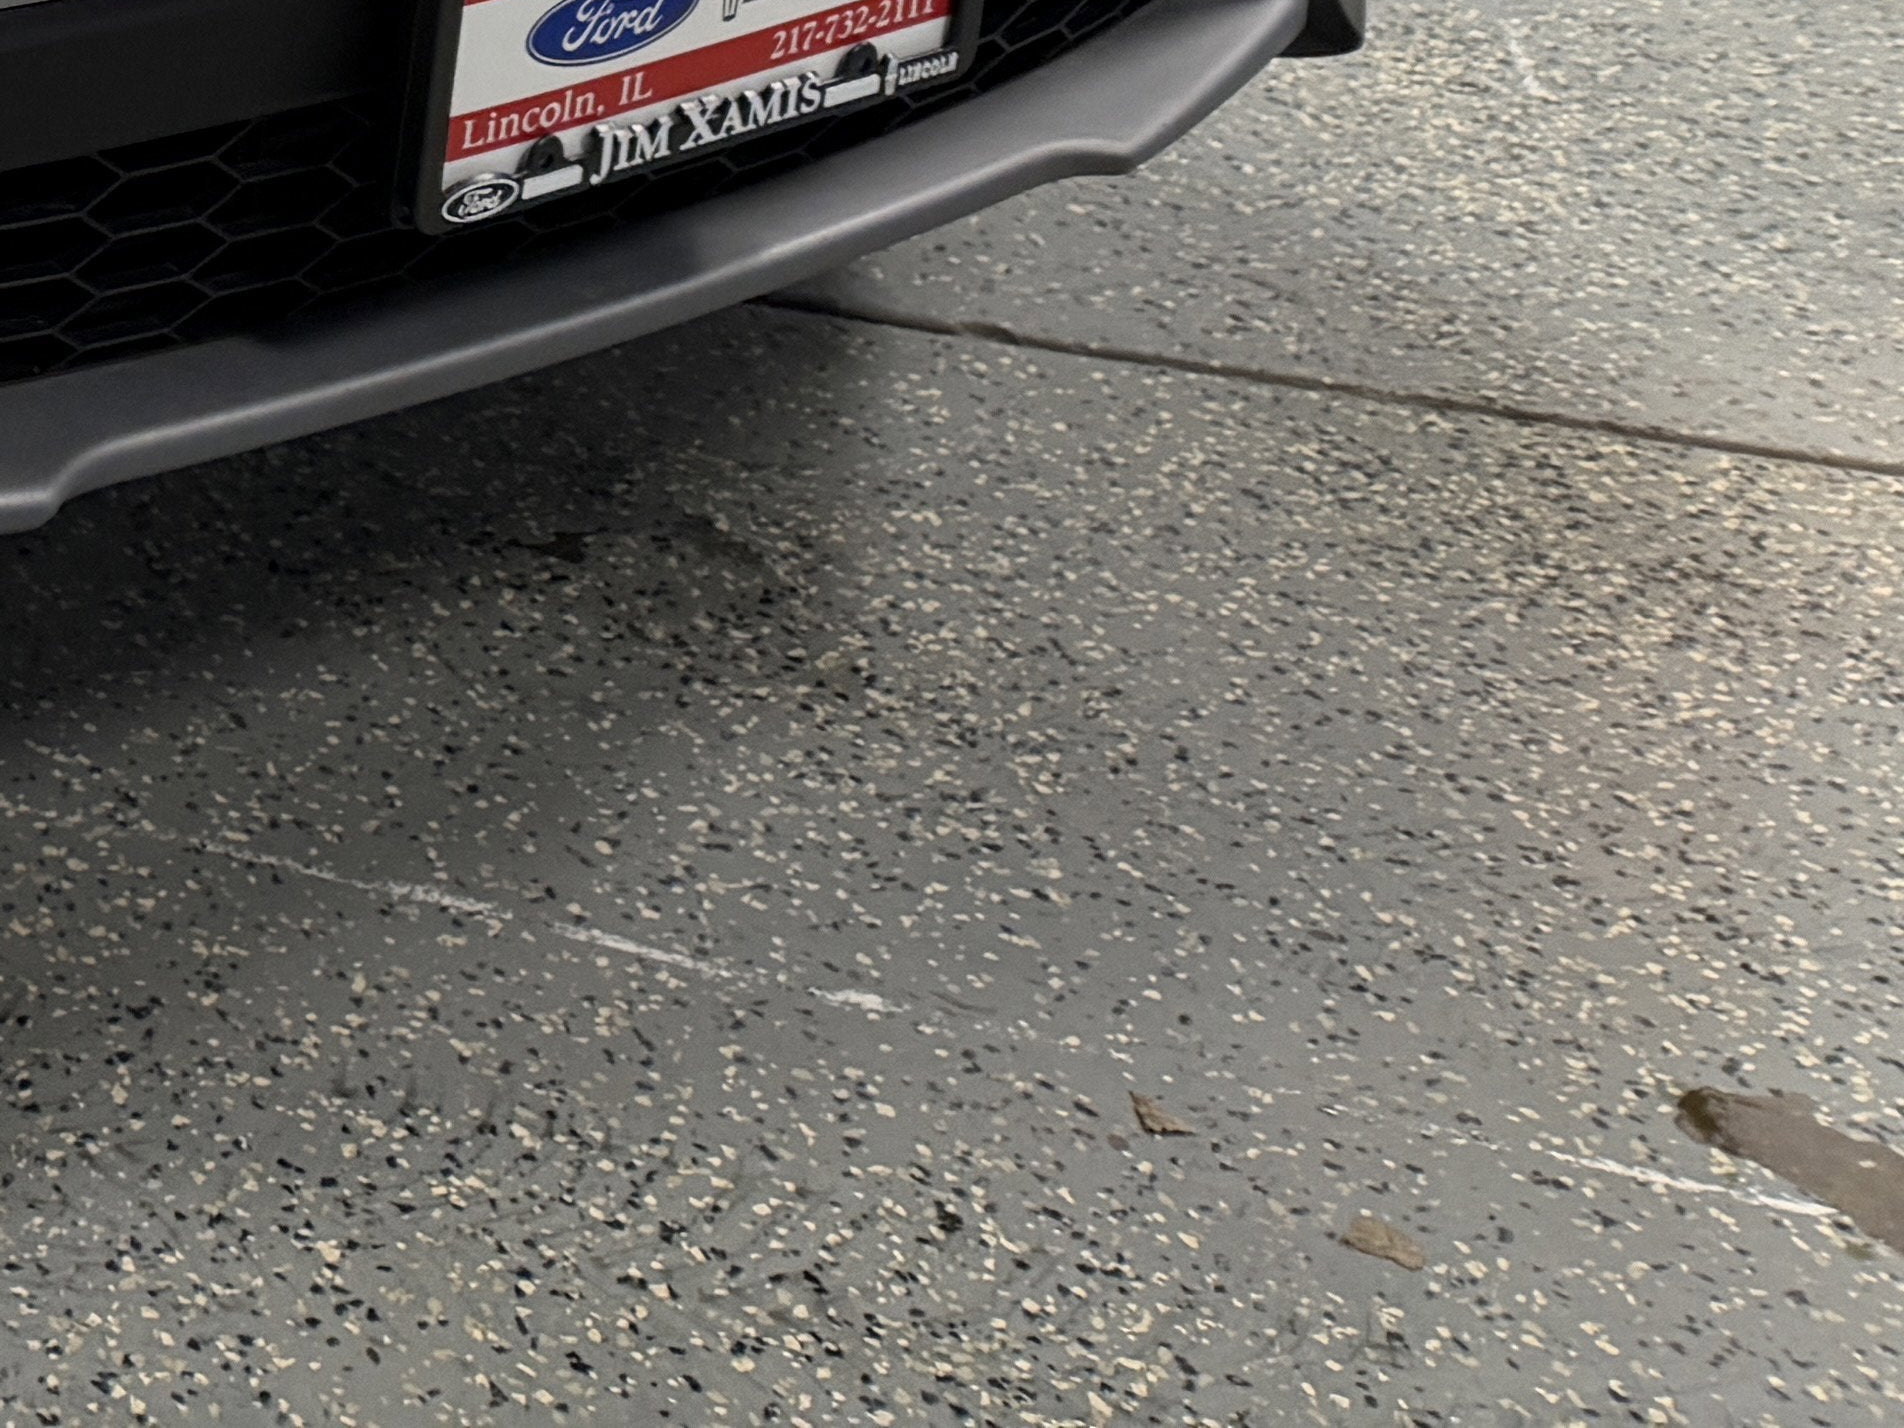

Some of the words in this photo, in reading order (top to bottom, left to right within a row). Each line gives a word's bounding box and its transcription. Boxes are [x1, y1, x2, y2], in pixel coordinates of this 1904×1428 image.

[897, 51, 960, 86] LINCOLN
[461, 88, 605, 150] Lincoln,
[618, 71, 653, 106] IL
[589, 116, 674, 185] JIM
[680, 71, 822, 151] XAMIS
[458, 187, 503, 218] Ford
